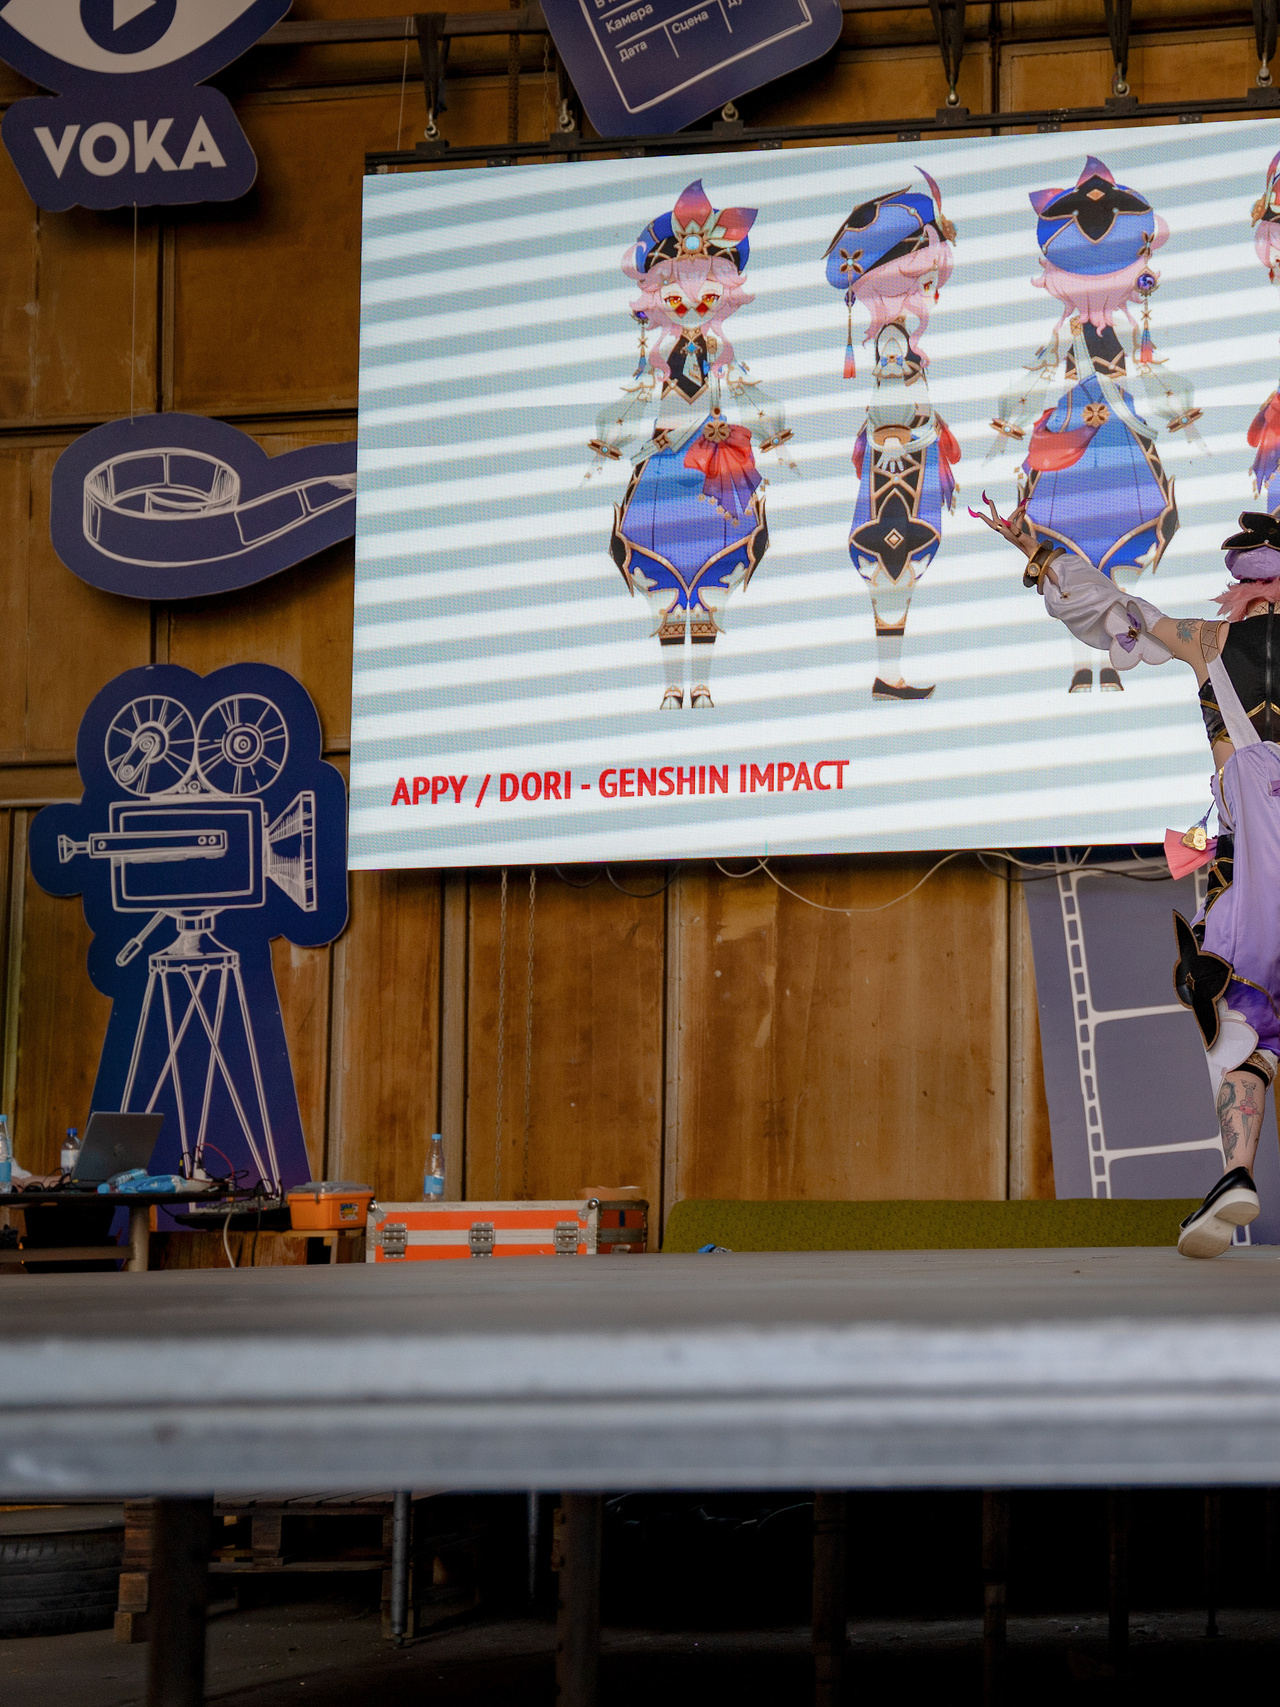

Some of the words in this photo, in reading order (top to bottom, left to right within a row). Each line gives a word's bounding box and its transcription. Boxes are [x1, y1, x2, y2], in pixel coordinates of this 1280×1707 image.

[605, 4, 654, 34] Камера
[671, 10, 709, 35] Сцена
[618, 41, 648, 63] Дата
[33, 115, 227, 179] VOKA
[391, 774, 468, 806] APPY
[499, 771, 573, 802] DORI
[599, 764, 729, 798] GENSHIN
[739, 760, 850, 793] IMPACT
